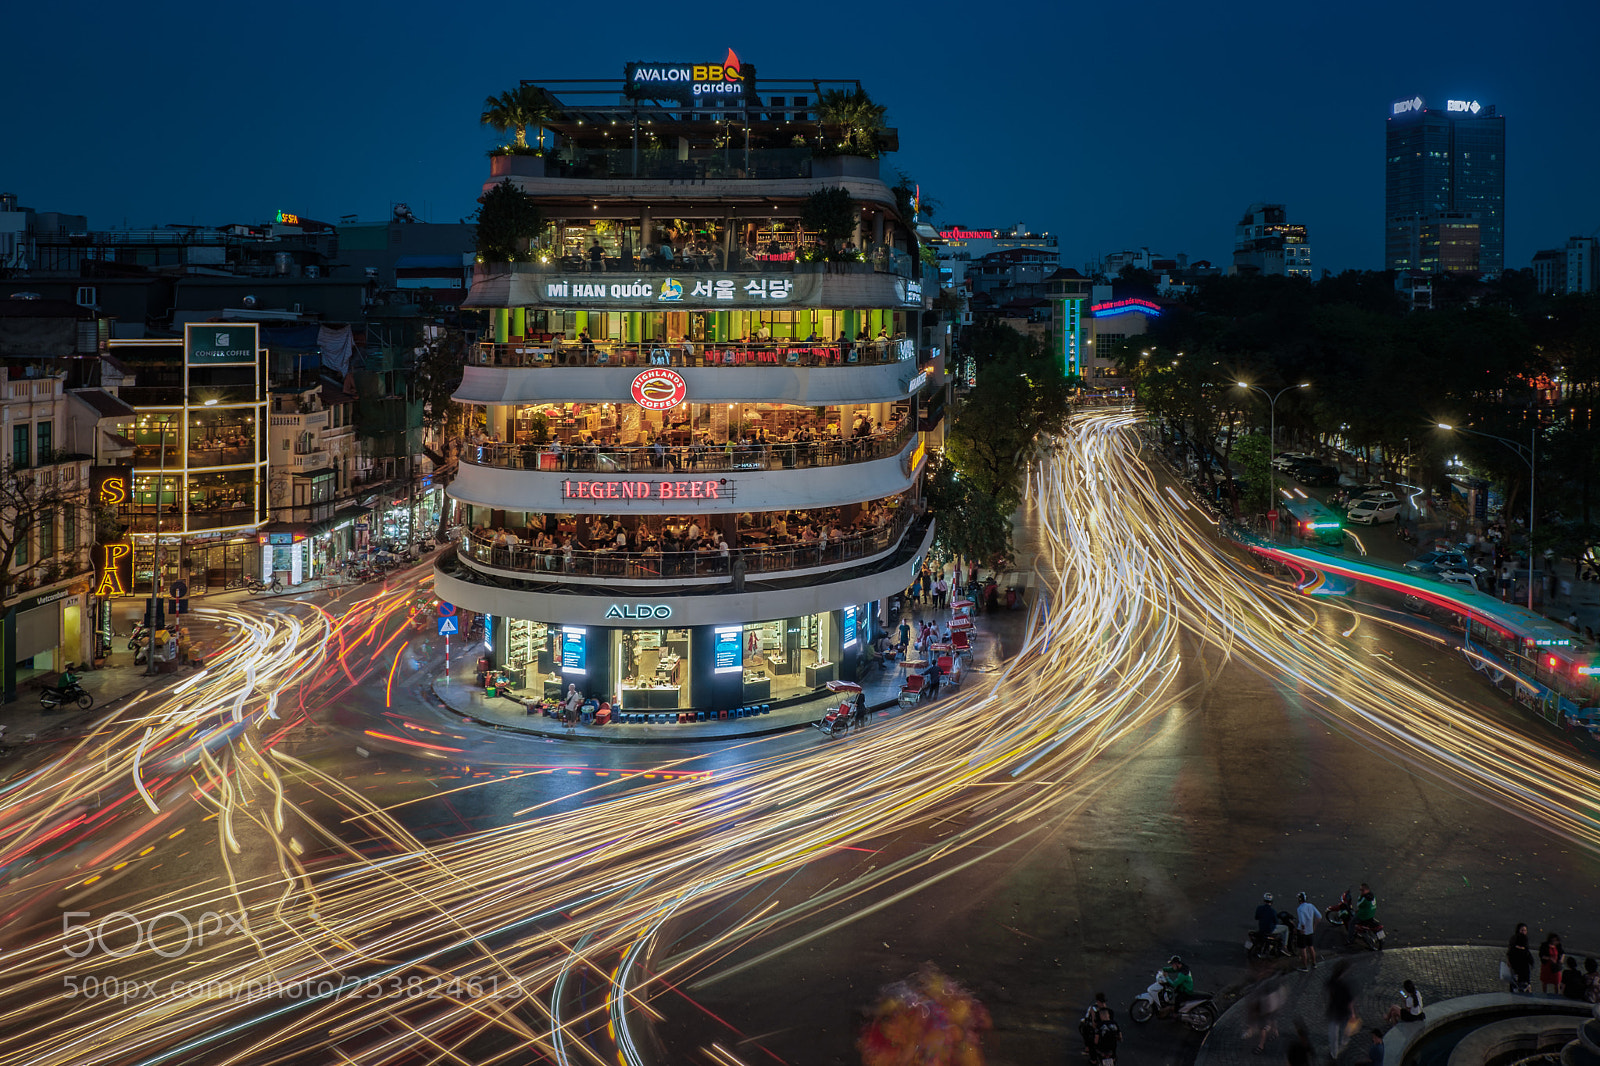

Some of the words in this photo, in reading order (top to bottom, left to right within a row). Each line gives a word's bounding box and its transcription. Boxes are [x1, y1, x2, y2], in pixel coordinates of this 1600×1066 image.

[634, 69, 690, 81] AVALON
[693, 82, 741, 95] garden
[953, 226, 974, 241] QUEEN
[974, 231, 993, 239] HOTEL
[690, 279, 736, 299] 서울
[743, 279, 793, 299] 식당
[633, 371, 684, 389] HIGHLANDS
[640, 397, 678, 408] COFFEE
[565, 480, 650, 499] LEGEND
[658, 480, 719, 499] BEER
[605, 604, 672, 620] ALDO
